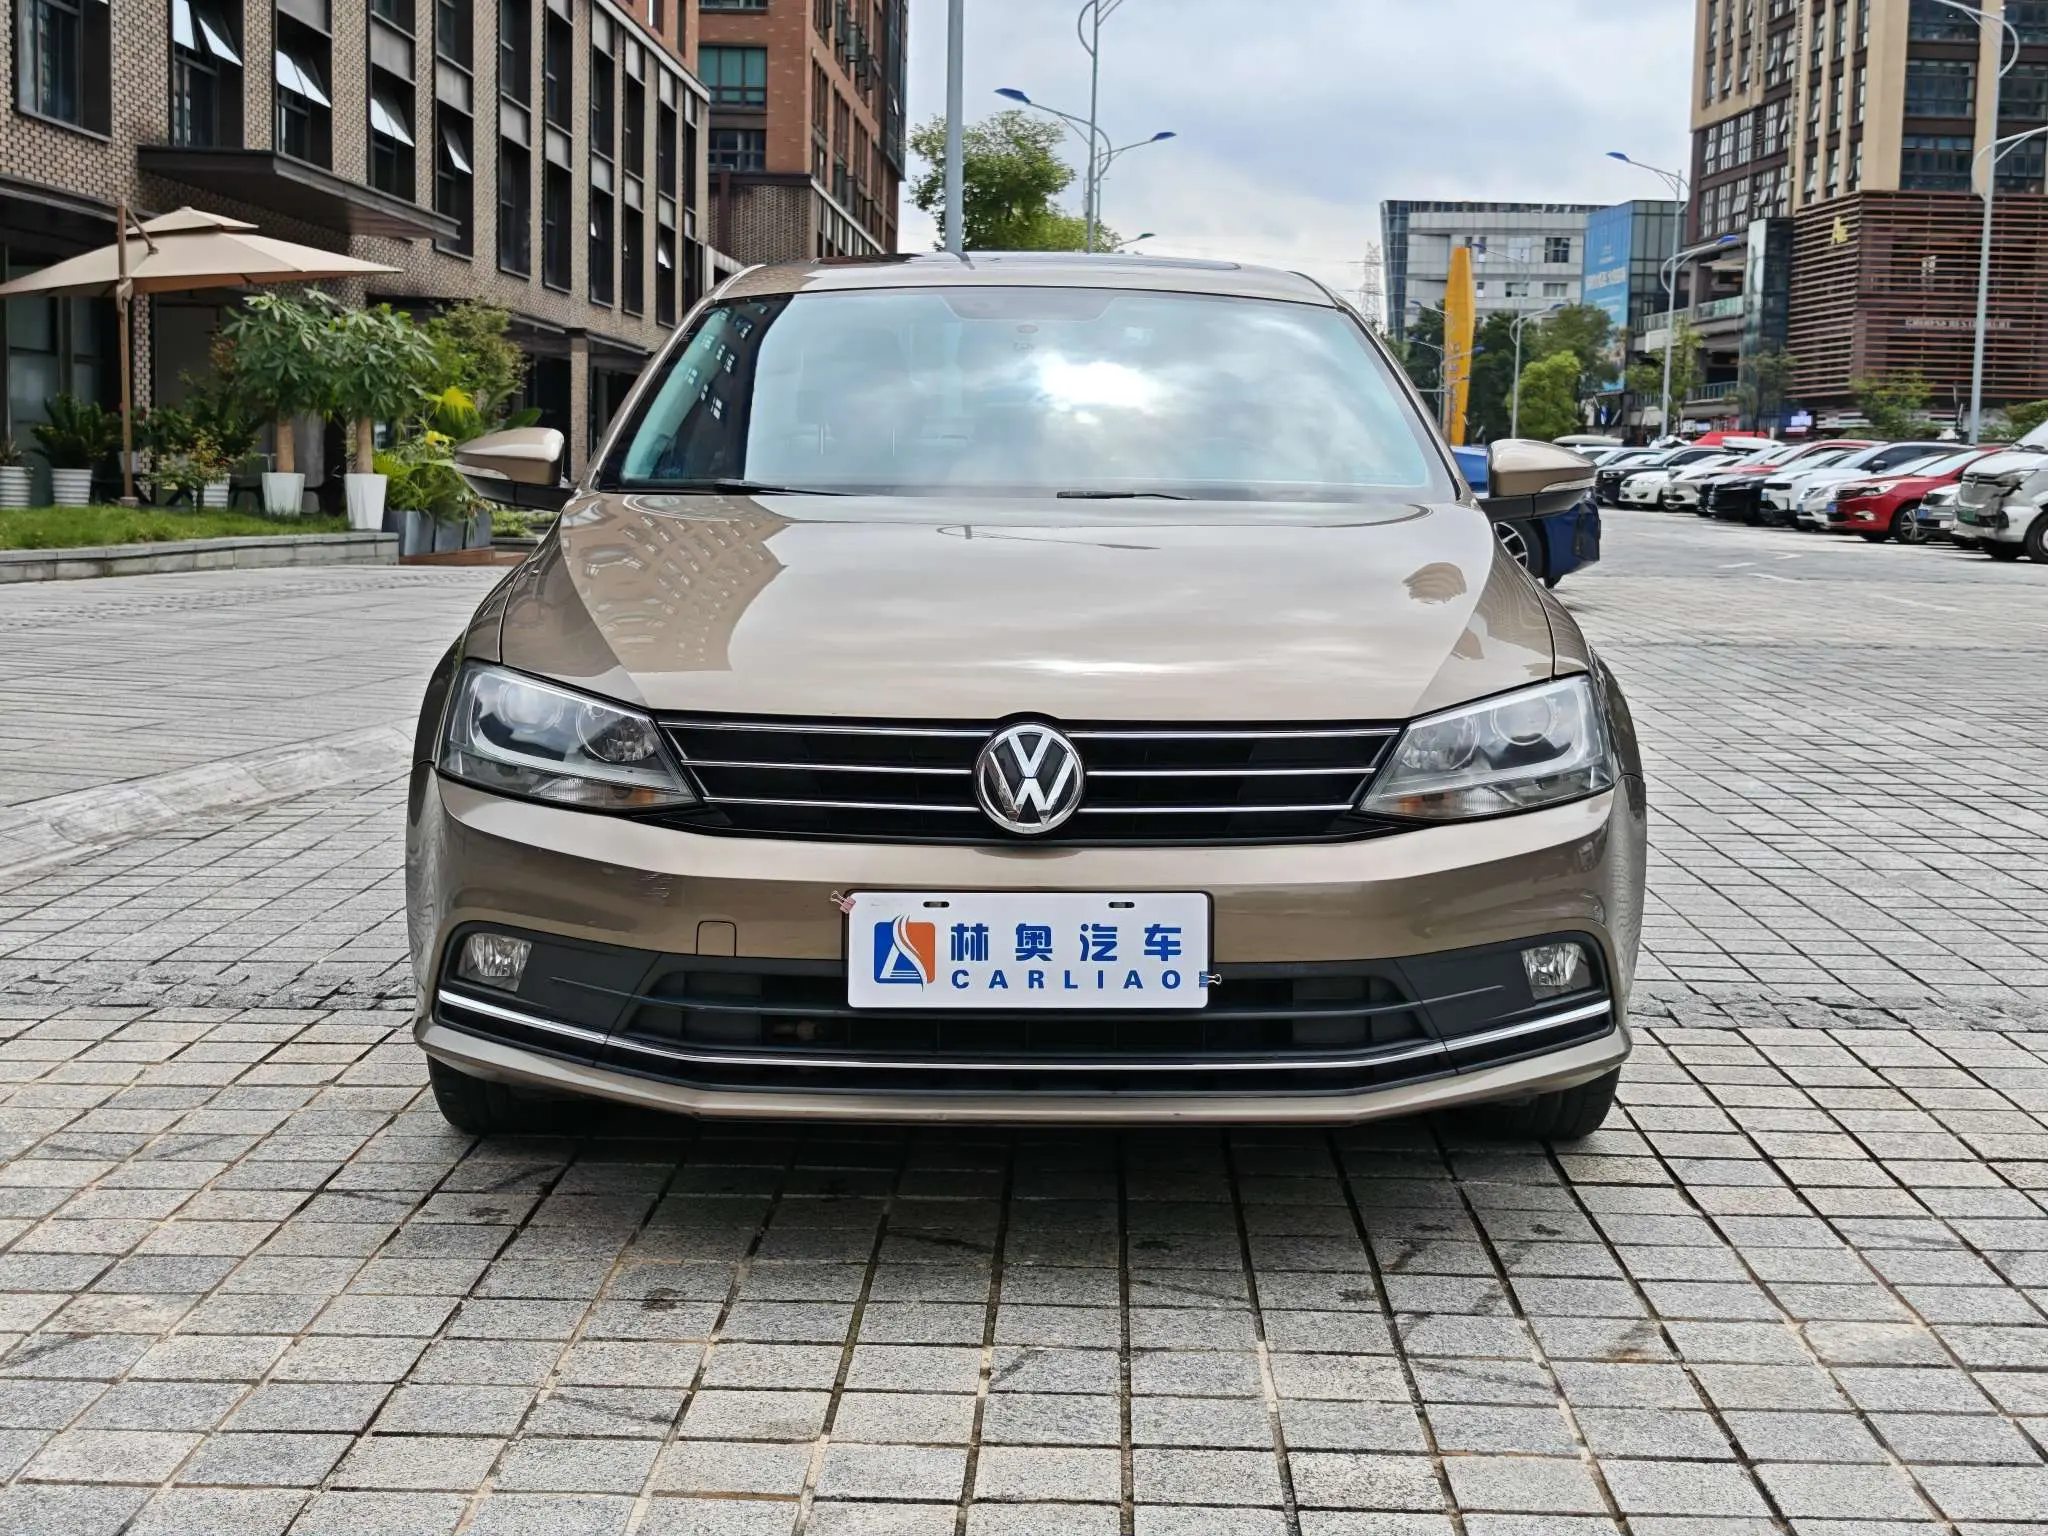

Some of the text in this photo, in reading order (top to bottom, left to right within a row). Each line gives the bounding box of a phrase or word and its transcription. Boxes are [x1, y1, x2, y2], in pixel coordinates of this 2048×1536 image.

[984, 728, 1077, 826] VW
[950, 923, 1182, 962] 林奥汽车
[951, 969, 1181, 990] CARLIAO
